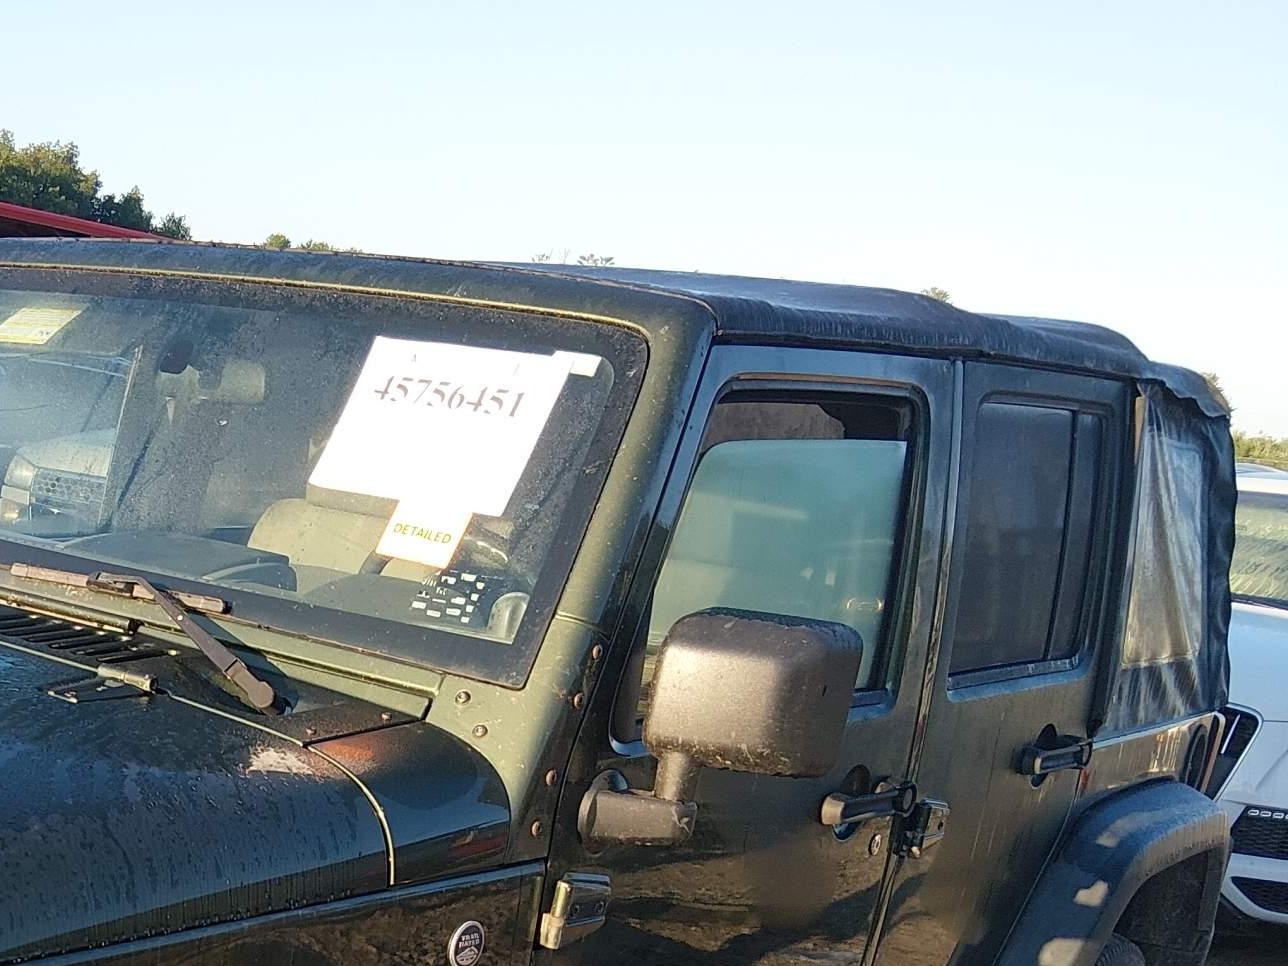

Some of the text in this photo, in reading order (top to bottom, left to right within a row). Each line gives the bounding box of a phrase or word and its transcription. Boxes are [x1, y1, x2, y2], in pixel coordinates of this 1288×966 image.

[374, 376, 525, 417] 45756451
[393, 521, 453, 545] DETAILED
[461, 933, 479, 941] TRAIL
